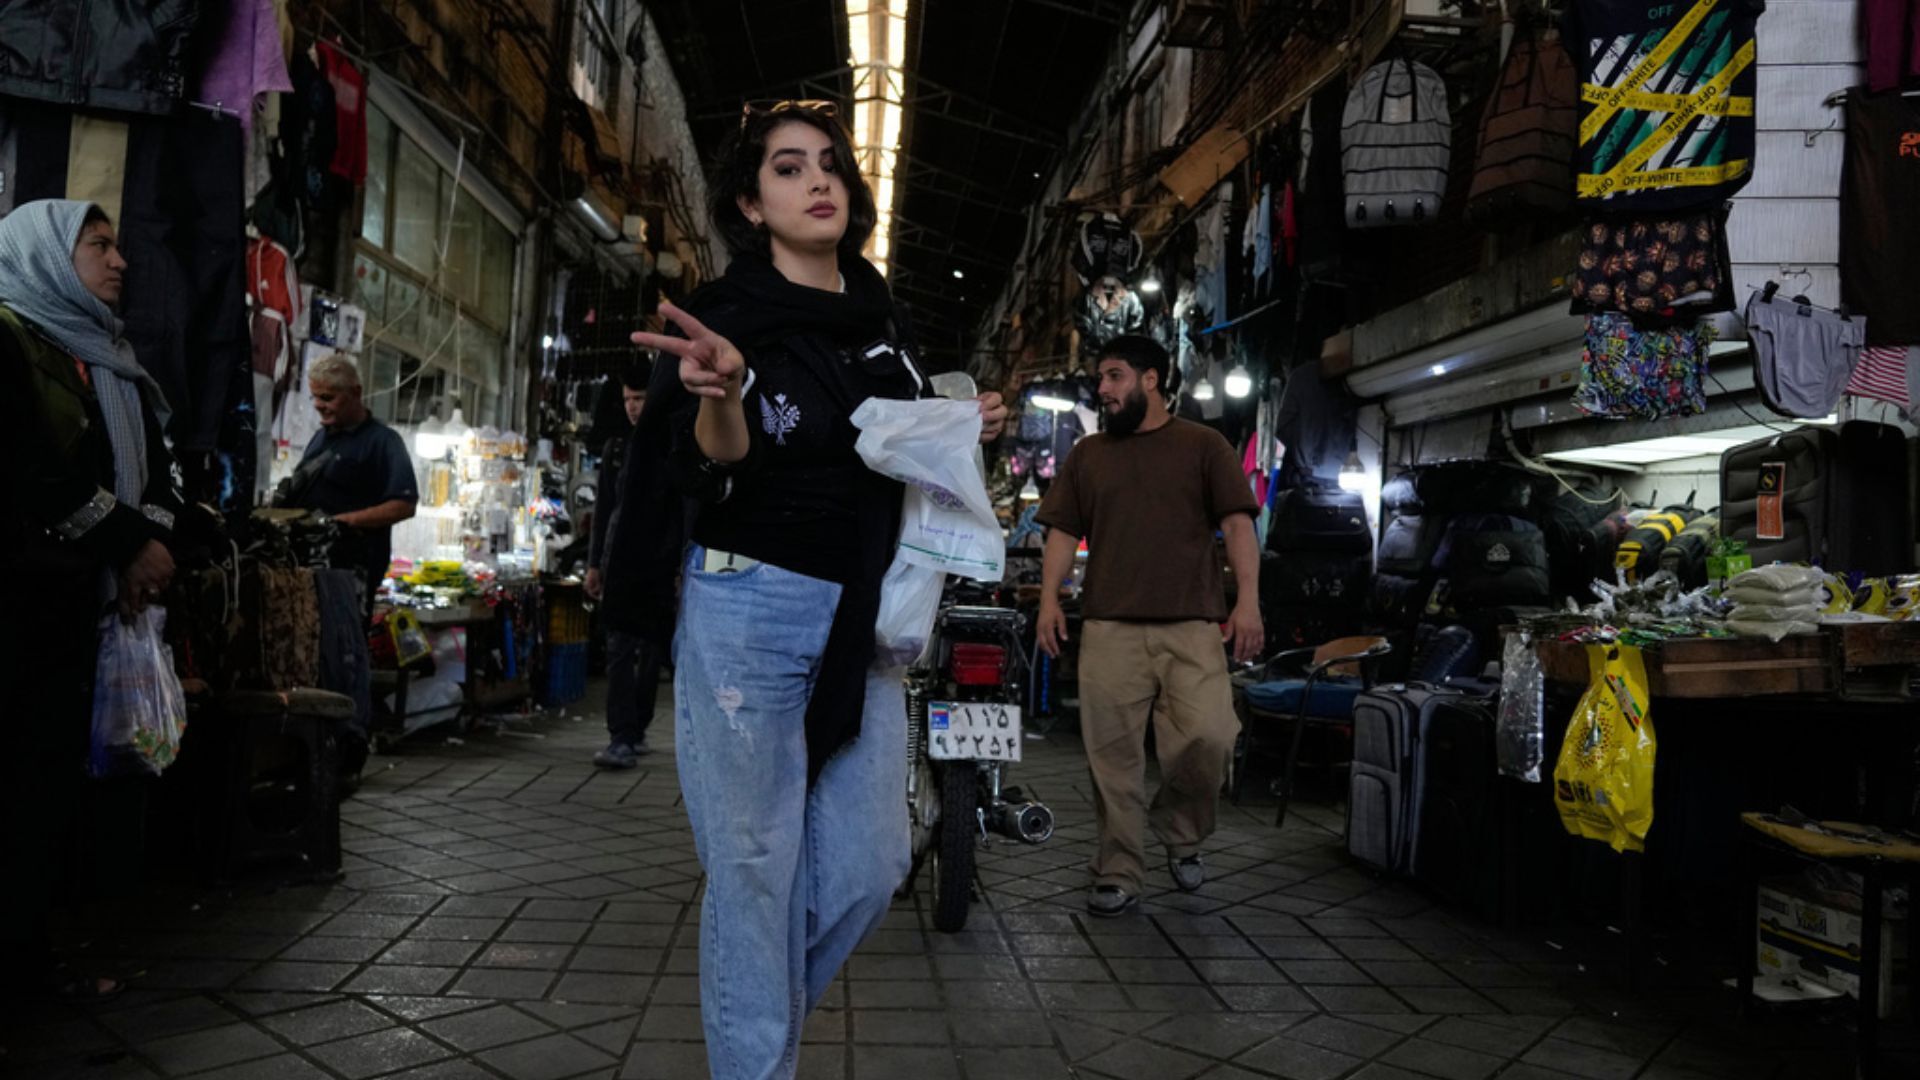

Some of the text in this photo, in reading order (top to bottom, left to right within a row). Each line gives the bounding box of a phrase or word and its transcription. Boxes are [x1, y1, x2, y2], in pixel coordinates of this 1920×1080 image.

[1647, 4, 1674, 20] OFF
[1608, 59, 1656, 108] OFF-WHITE
[1665, 85, 1717, 136] OFF-WHITE
[1623, 171, 1683, 187] OFF-WHITE
[964, 707, 1009, 728] ۱۱۵
